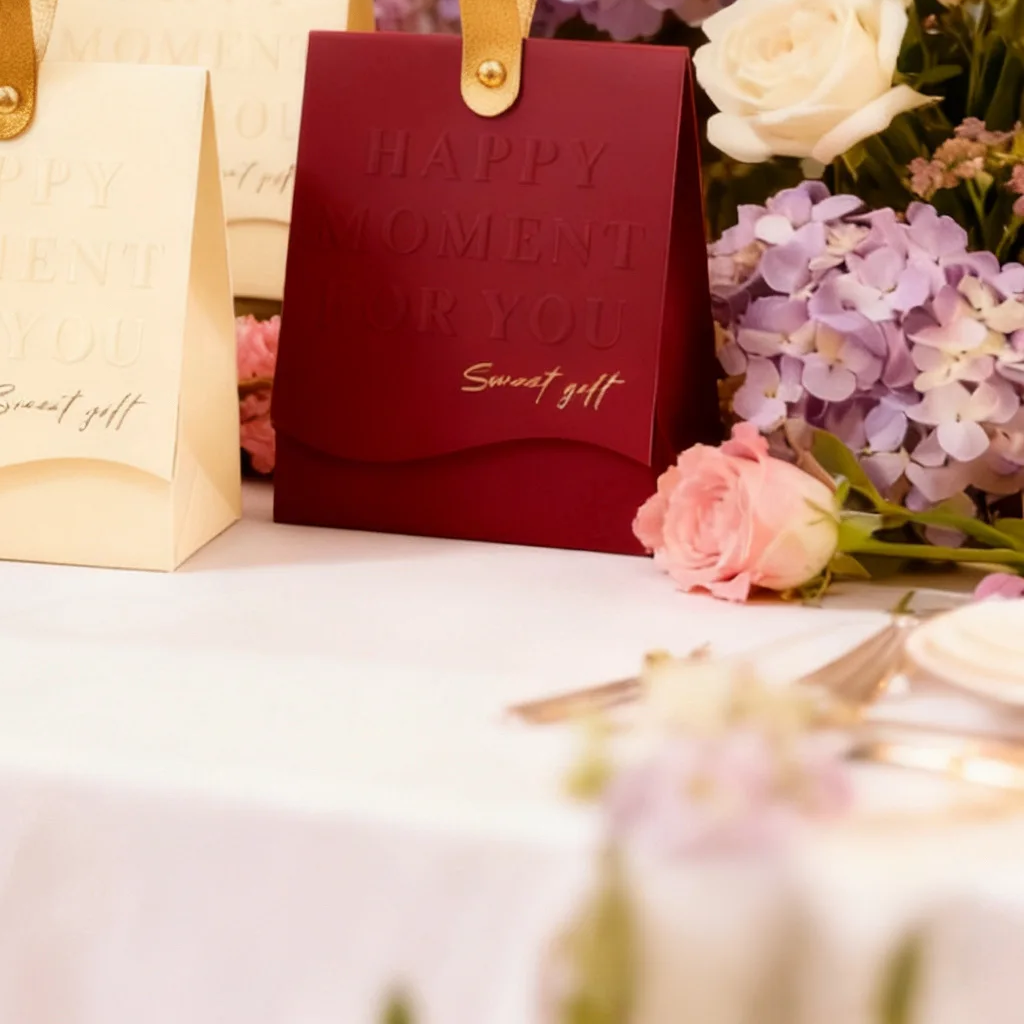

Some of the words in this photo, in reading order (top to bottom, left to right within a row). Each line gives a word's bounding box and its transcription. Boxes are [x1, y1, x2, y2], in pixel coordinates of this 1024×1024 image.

[364, 127, 612, 189] HAPPY
[306, 206, 647, 270] MOMENT
[315, 279, 459, 339] FOR
[480, 287, 629, 351] YOU
